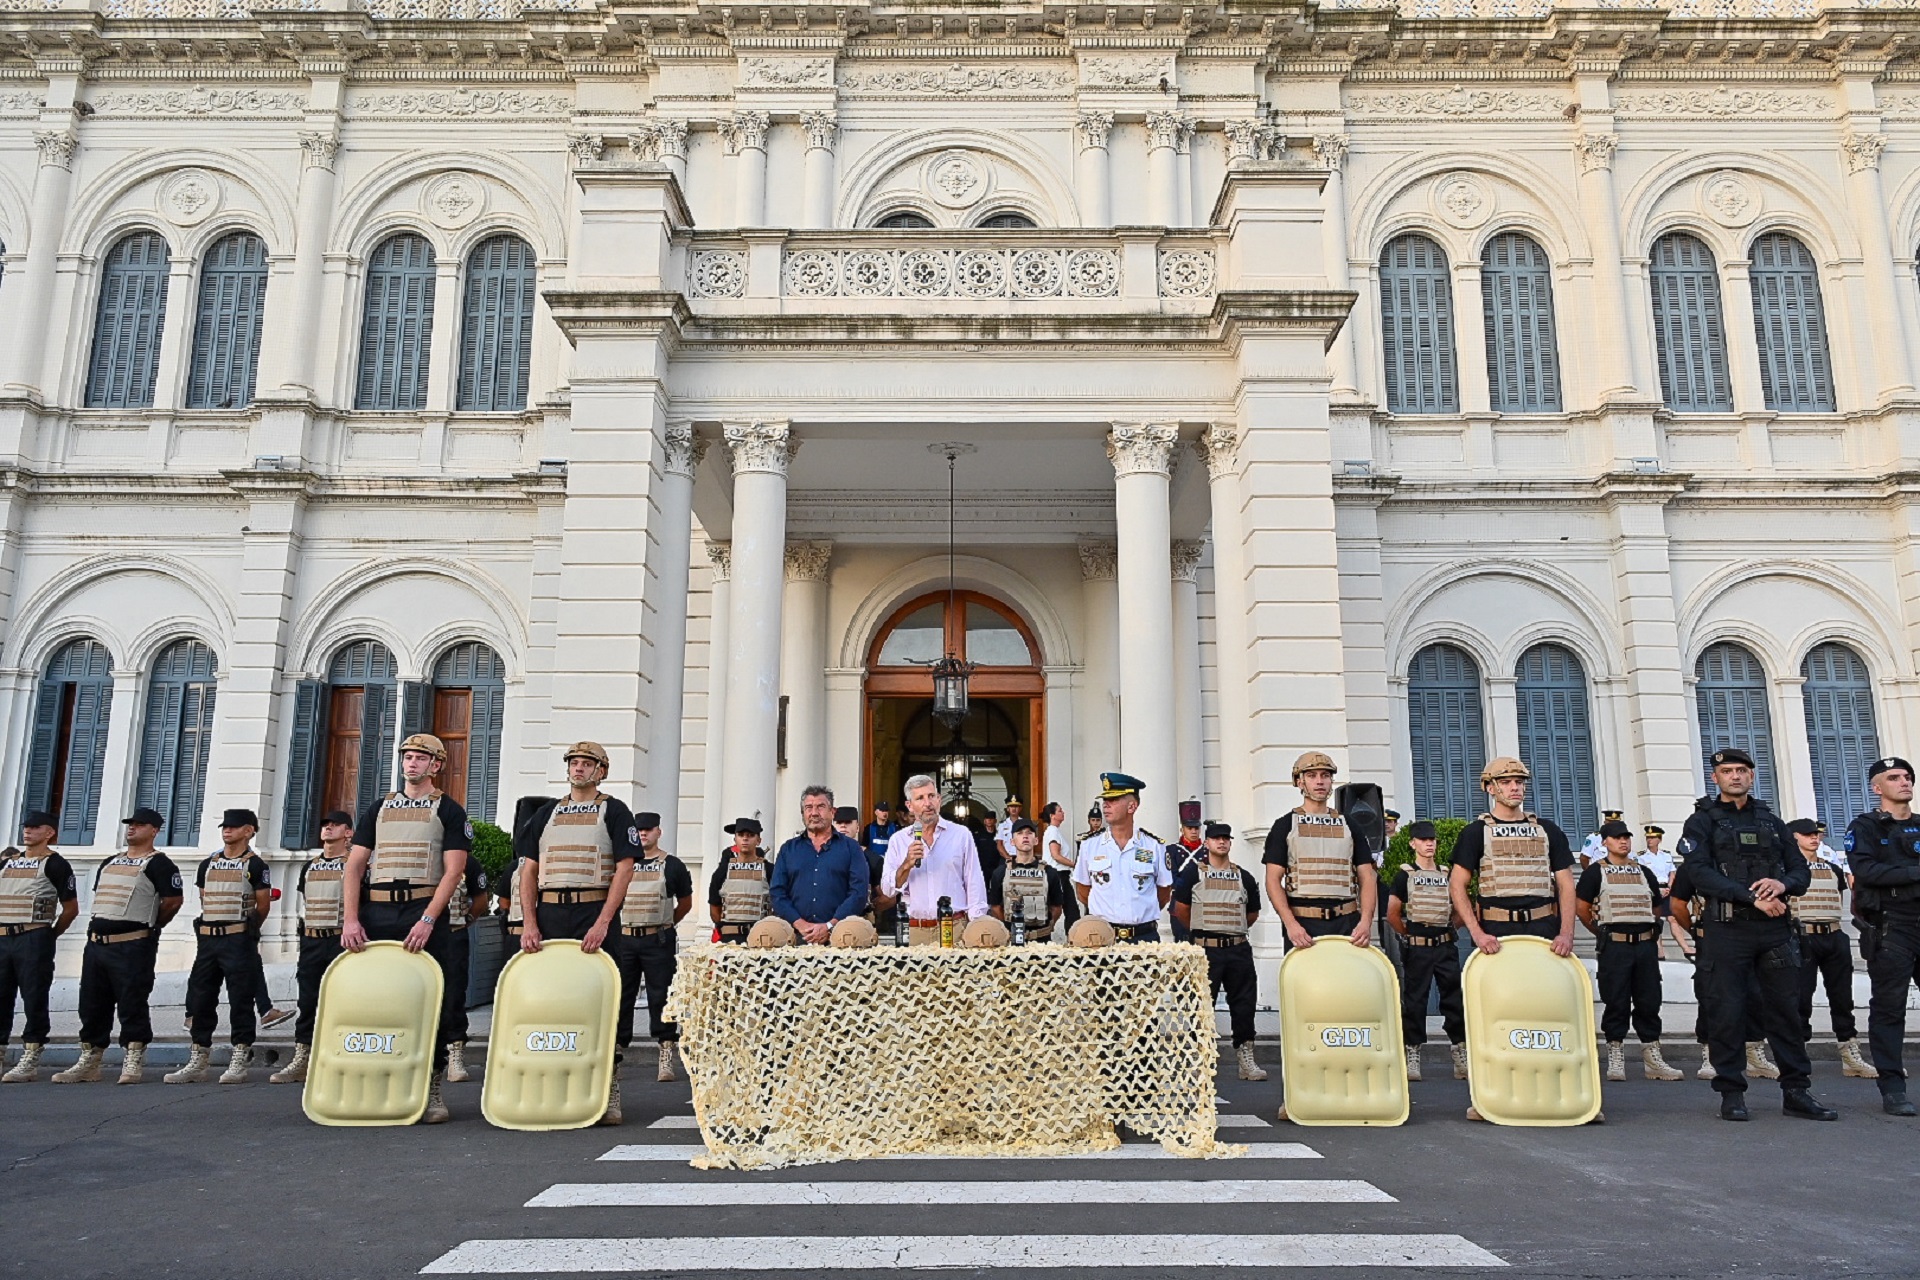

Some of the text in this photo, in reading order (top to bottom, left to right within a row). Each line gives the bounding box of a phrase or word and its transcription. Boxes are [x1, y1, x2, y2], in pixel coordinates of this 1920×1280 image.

[386, 799, 431, 808] POLICIA
[556, 804, 598, 814] POLICIA
[1298, 815, 1342, 825] POLICIA
[1492, 826, 1538, 837] POLICIA
[4, 858, 39, 869] POLICIA
[209, 861, 243, 870] POLICIA
[309, 862, 342, 871] POLICIA
[633, 863, 660, 872] OLICIA
[729, 862, 762, 870] POLICIA
[1010, 869, 1043, 878] POLICIA
[1605, 866, 1641, 874] POLICIA
[1207, 871, 1240, 880] POLICIA
[1414, 876, 1448, 885] POLICIA
[526, 1031, 577, 1051] GDI
[1321, 1027, 1372, 1048] GDI
[1509, 1029, 1562, 1051] GDI
[344, 1032, 395, 1054] GDI
